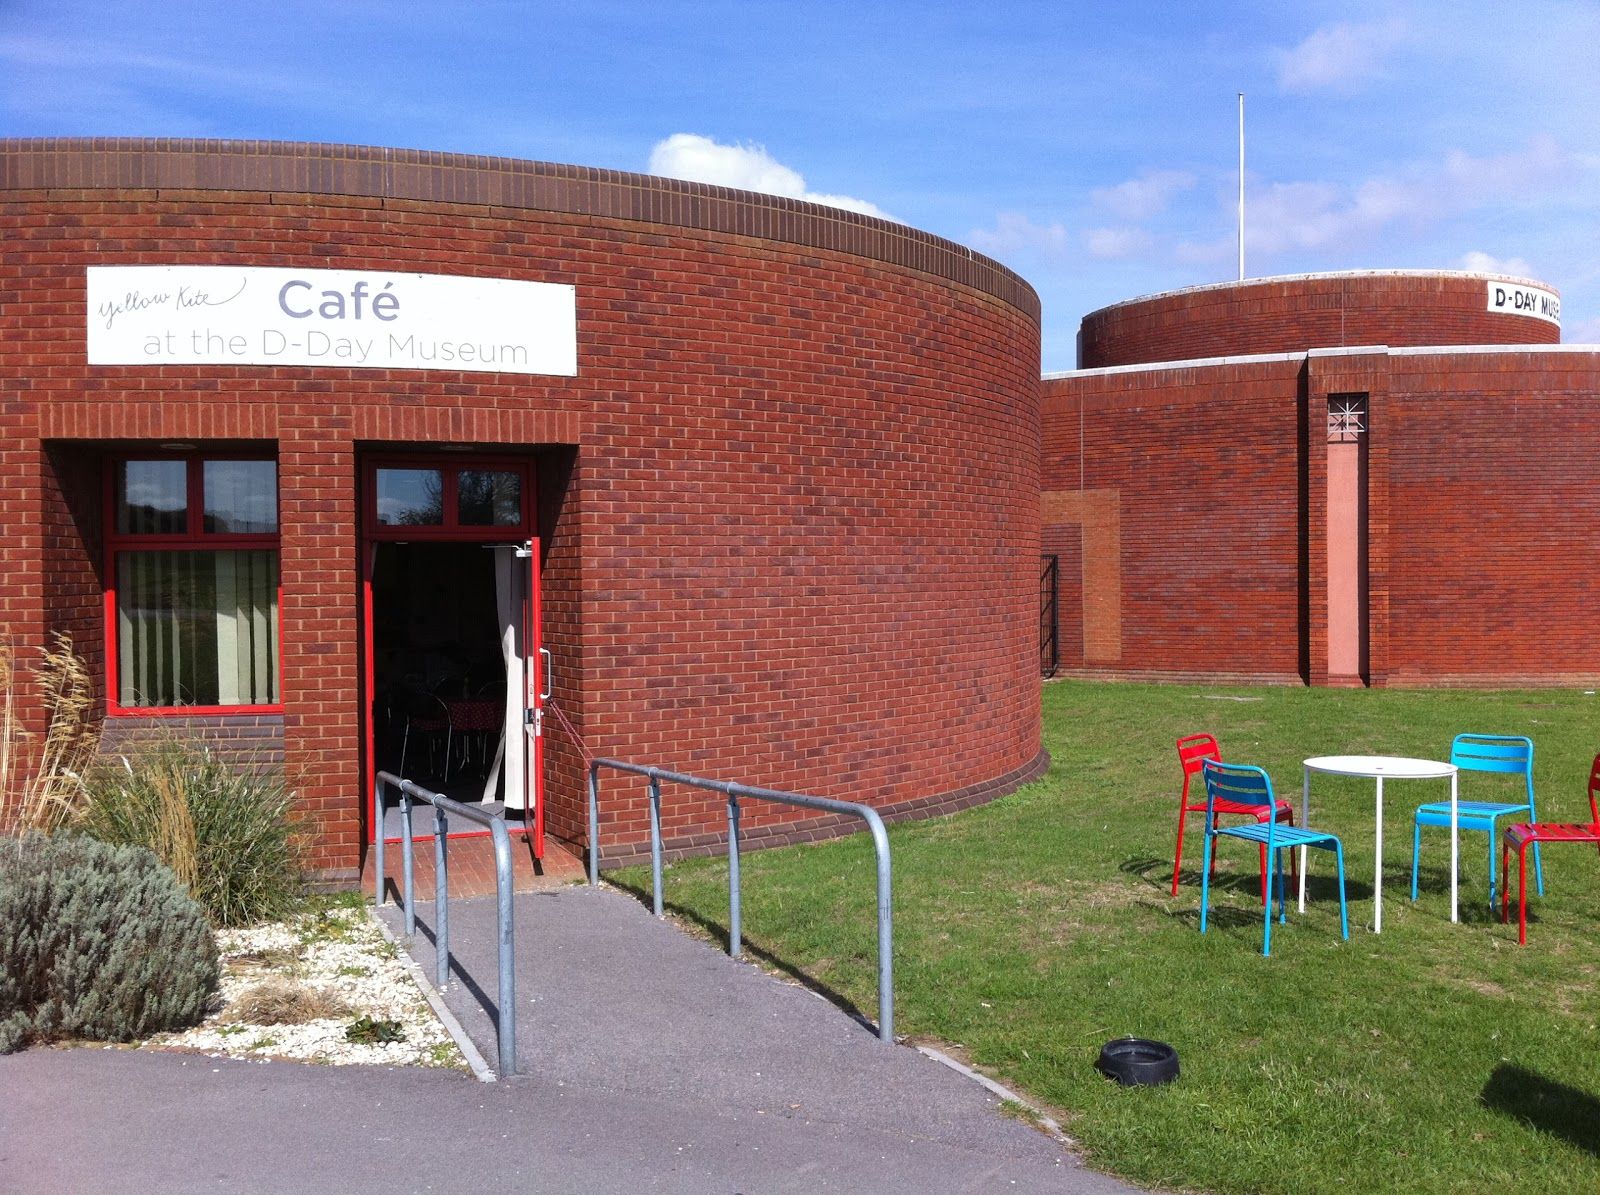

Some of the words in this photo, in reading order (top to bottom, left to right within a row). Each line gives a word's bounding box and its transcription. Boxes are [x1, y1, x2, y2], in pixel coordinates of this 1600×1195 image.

[176, 276, 246, 311] Kite
[278, 279, 400, 322] Café
[1495, 288, 1537, 312] D-DAY
[143, 329, 176, 356] at
[190, 328, 248, 356] the
[263, 329, 374, 363] D-Day
[389, 333, 528, 365] Museum
